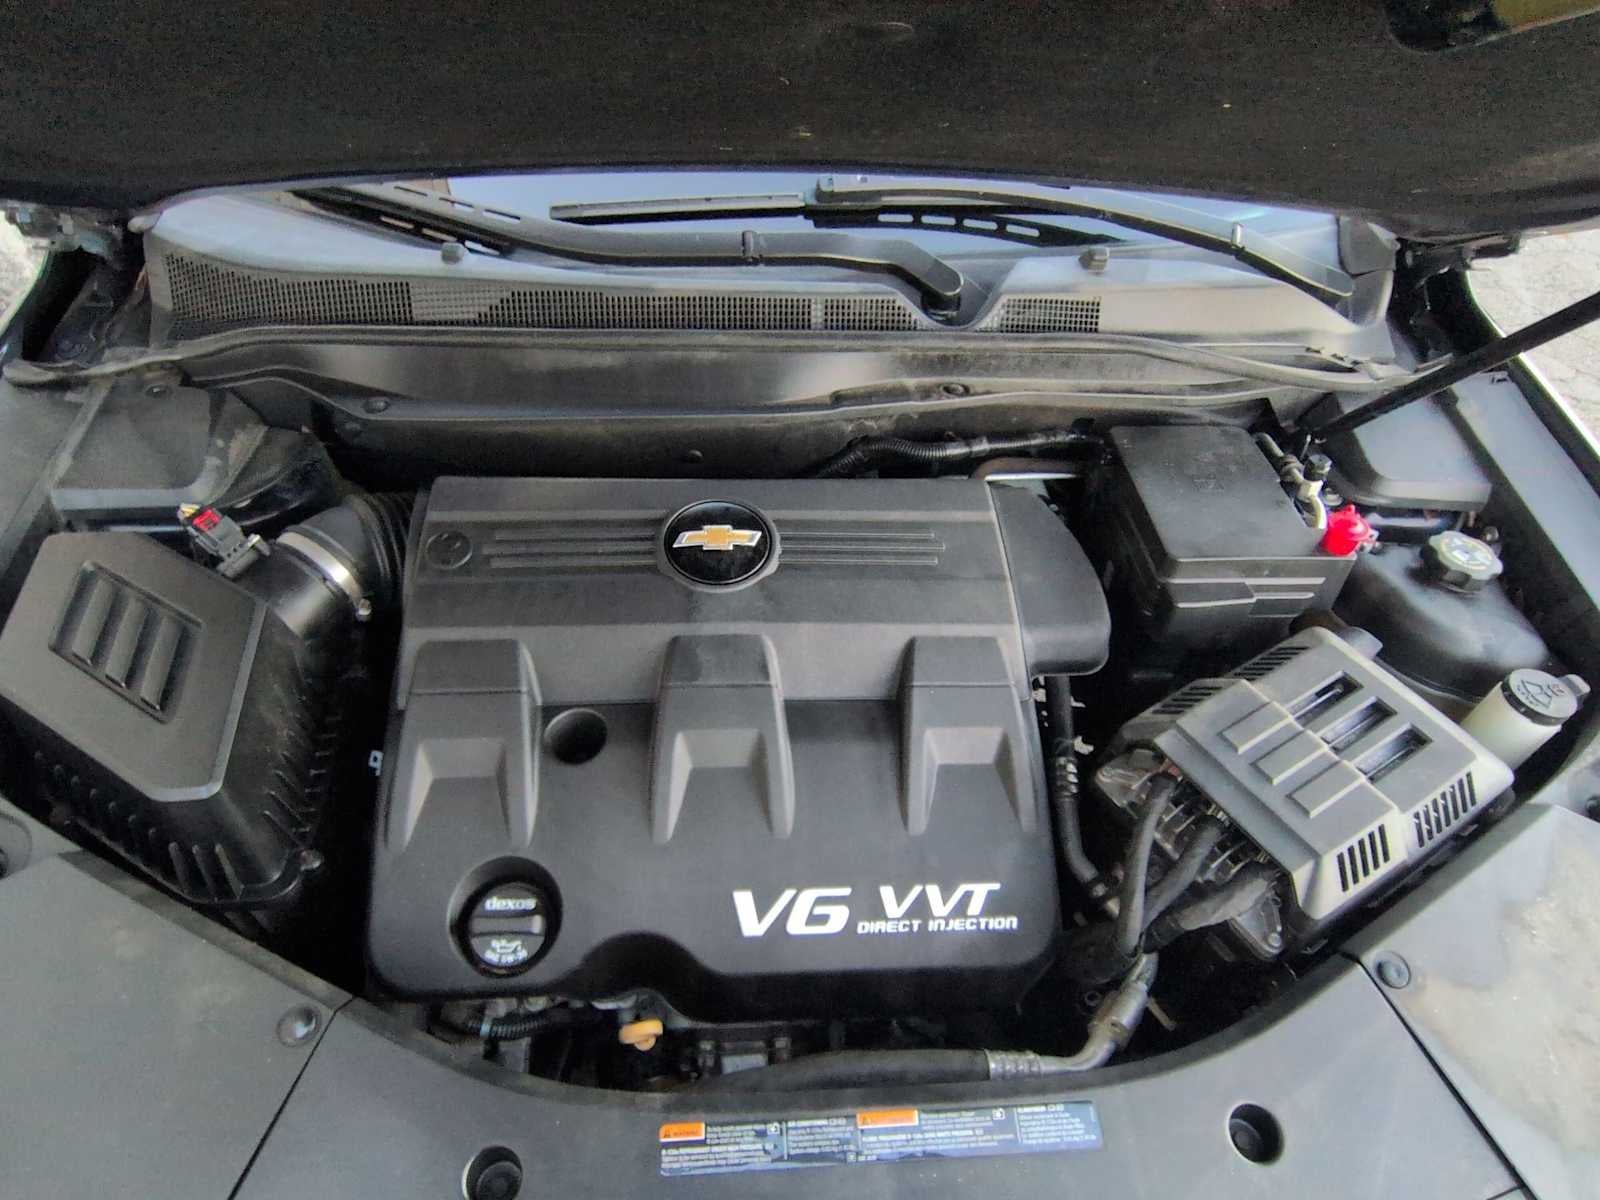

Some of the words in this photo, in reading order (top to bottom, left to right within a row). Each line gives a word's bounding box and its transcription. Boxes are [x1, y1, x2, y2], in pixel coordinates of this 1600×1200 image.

[484, 896, 537, 911] dexos
[732, 887, 852, 937] V6
[879, 883, 1001, 919] VVT
[857, 919, 922, 935] DIRECT
[928, 915, 1019, 931] INJECTION
